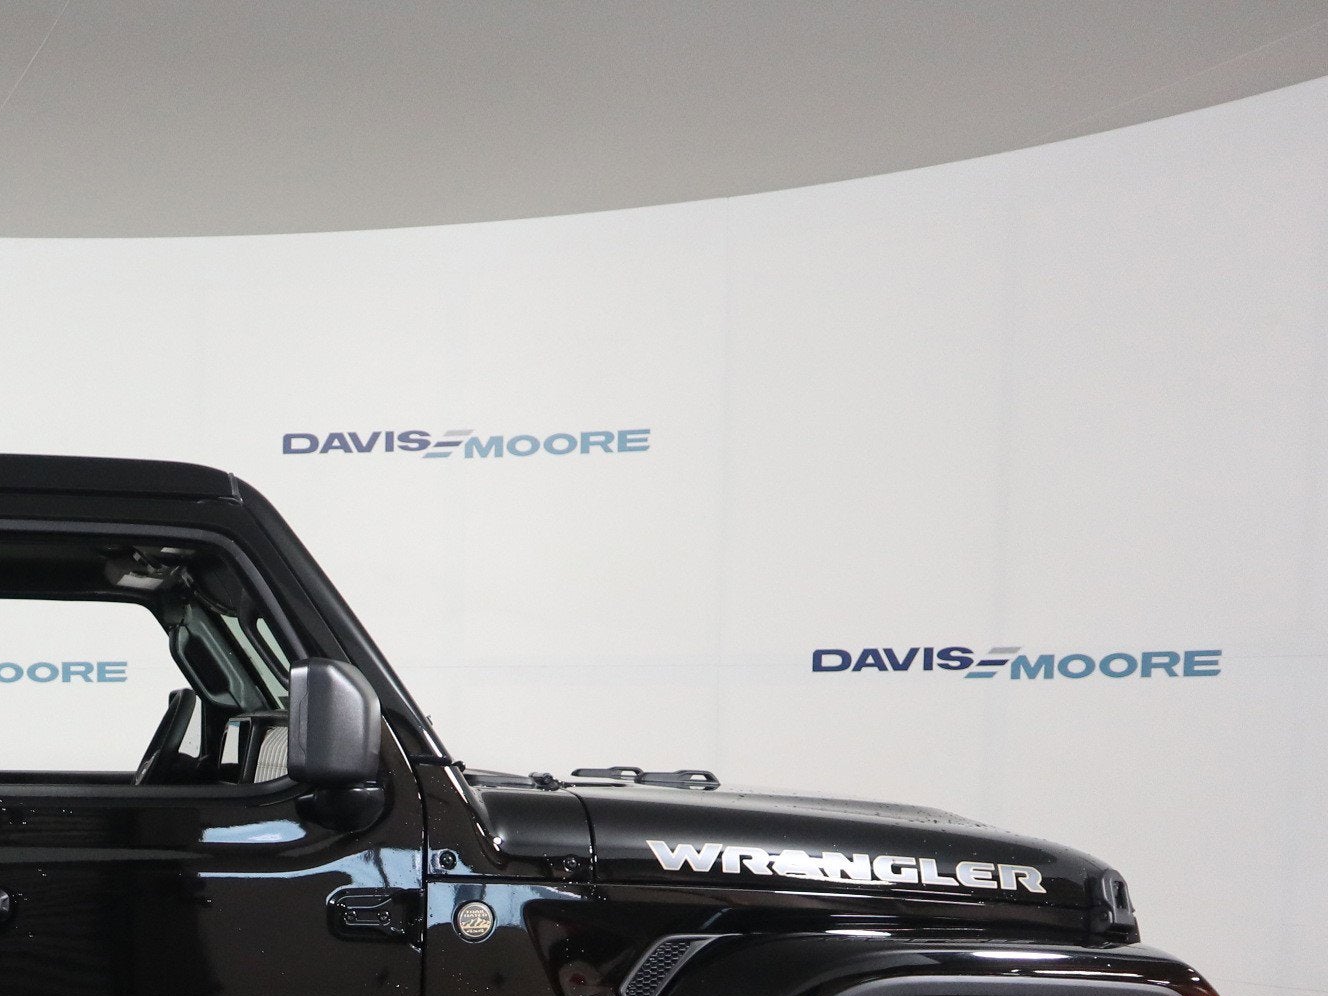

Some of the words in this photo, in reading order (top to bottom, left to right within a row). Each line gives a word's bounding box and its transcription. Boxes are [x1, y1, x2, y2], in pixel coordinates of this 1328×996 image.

[282, 429, 432, 454] DAVIS
[464, 429, 650, 458] MOORE
[811, 646, 975, 672] DAVIS
[1009, 649, 1223, 680] MOORE
[645, 839, 1047, 894] WRANGLER
